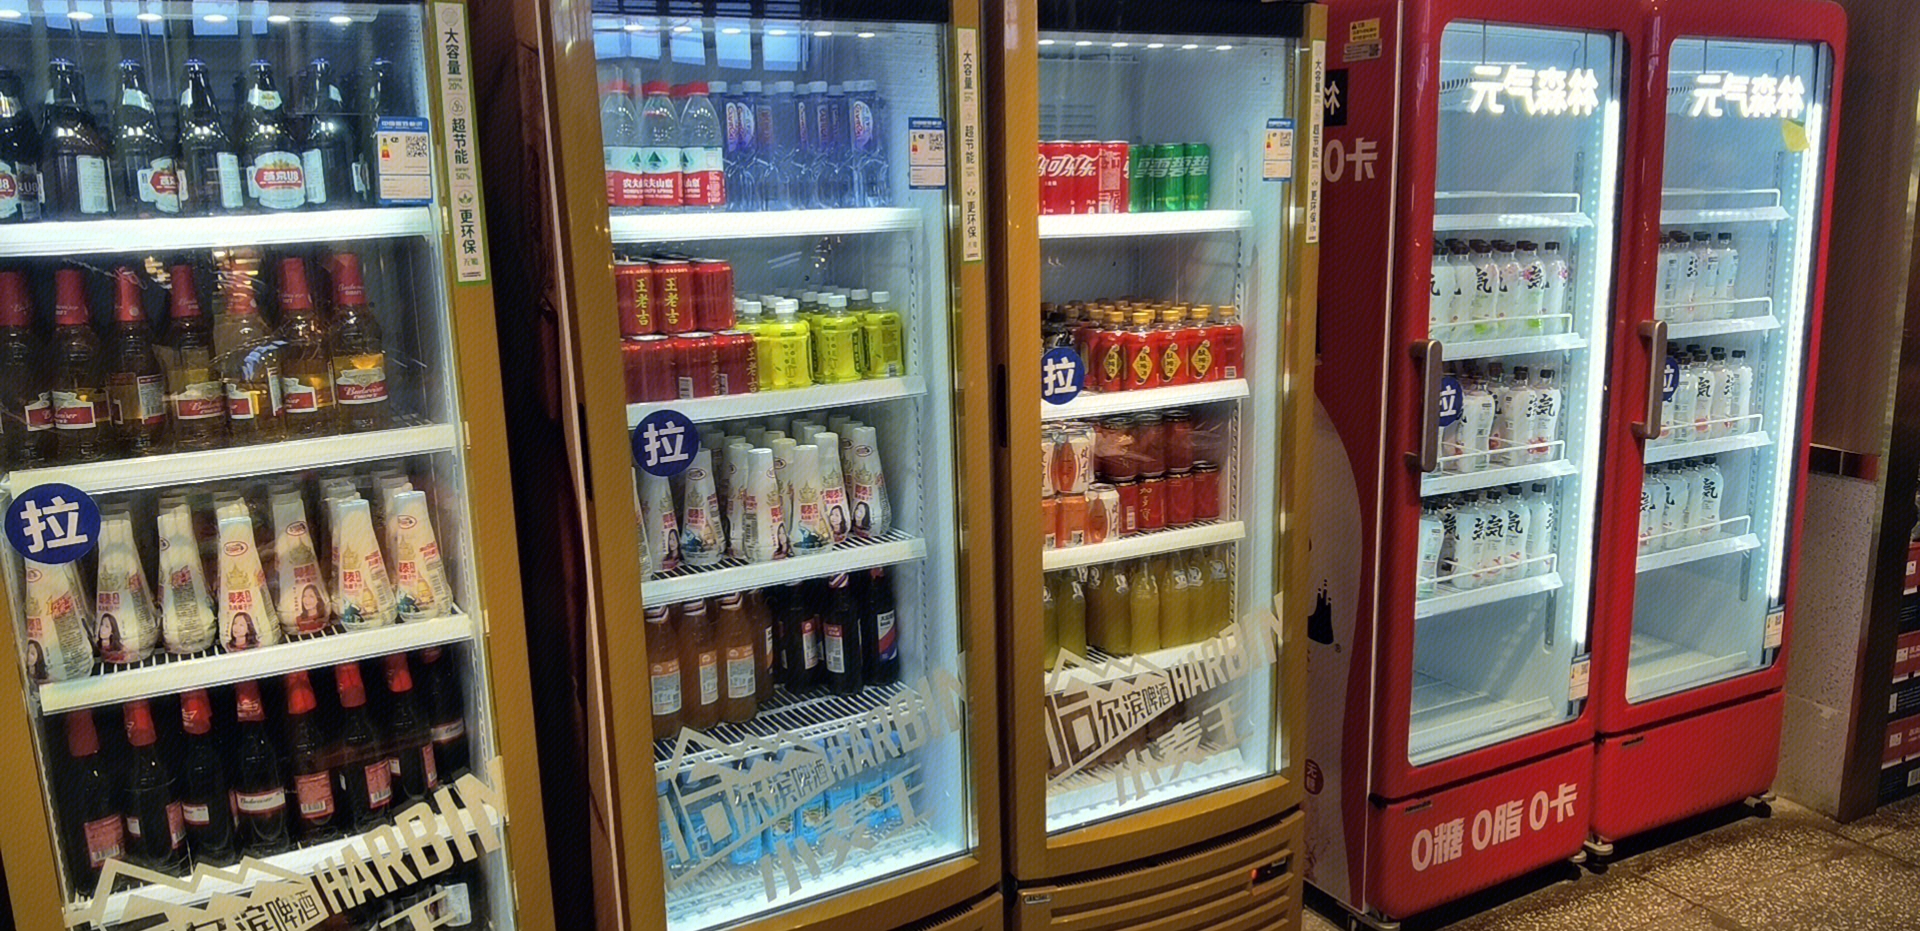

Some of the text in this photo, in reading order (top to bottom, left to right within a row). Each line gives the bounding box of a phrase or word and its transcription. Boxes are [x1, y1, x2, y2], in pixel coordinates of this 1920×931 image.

[445, 28, 461, 75] 大容量
[963, 50, 973, 90] 大容量
[1470, 64, 1599, 116] 元气森林
[1692, 71, 1805, 118] 元气森林
[452, 119, 469, 164] 超节能
[1323, 137, 1379, 183] 0卡
[459, 209, 477, 254] 更环保
[636, 278, 650, 326] 王老吉
[665, 276, 680, 325] 王老吉
[1043, 357, 1078, 396] 拉
[643, 421, 689, 466] 拉
[20, 496, 89, 554] 拉
[1171, 591, 1284, 703] HARBIN
[825, 650, 966, 782] HARBIN
[1114, 692, 1250, 806] 小麦王
[313, 756, 510, 915] HARBIN
[758, 762, 928, 903] 小麦王
[1410, 782, 1578, 872] 0糖 0脂 0卡
